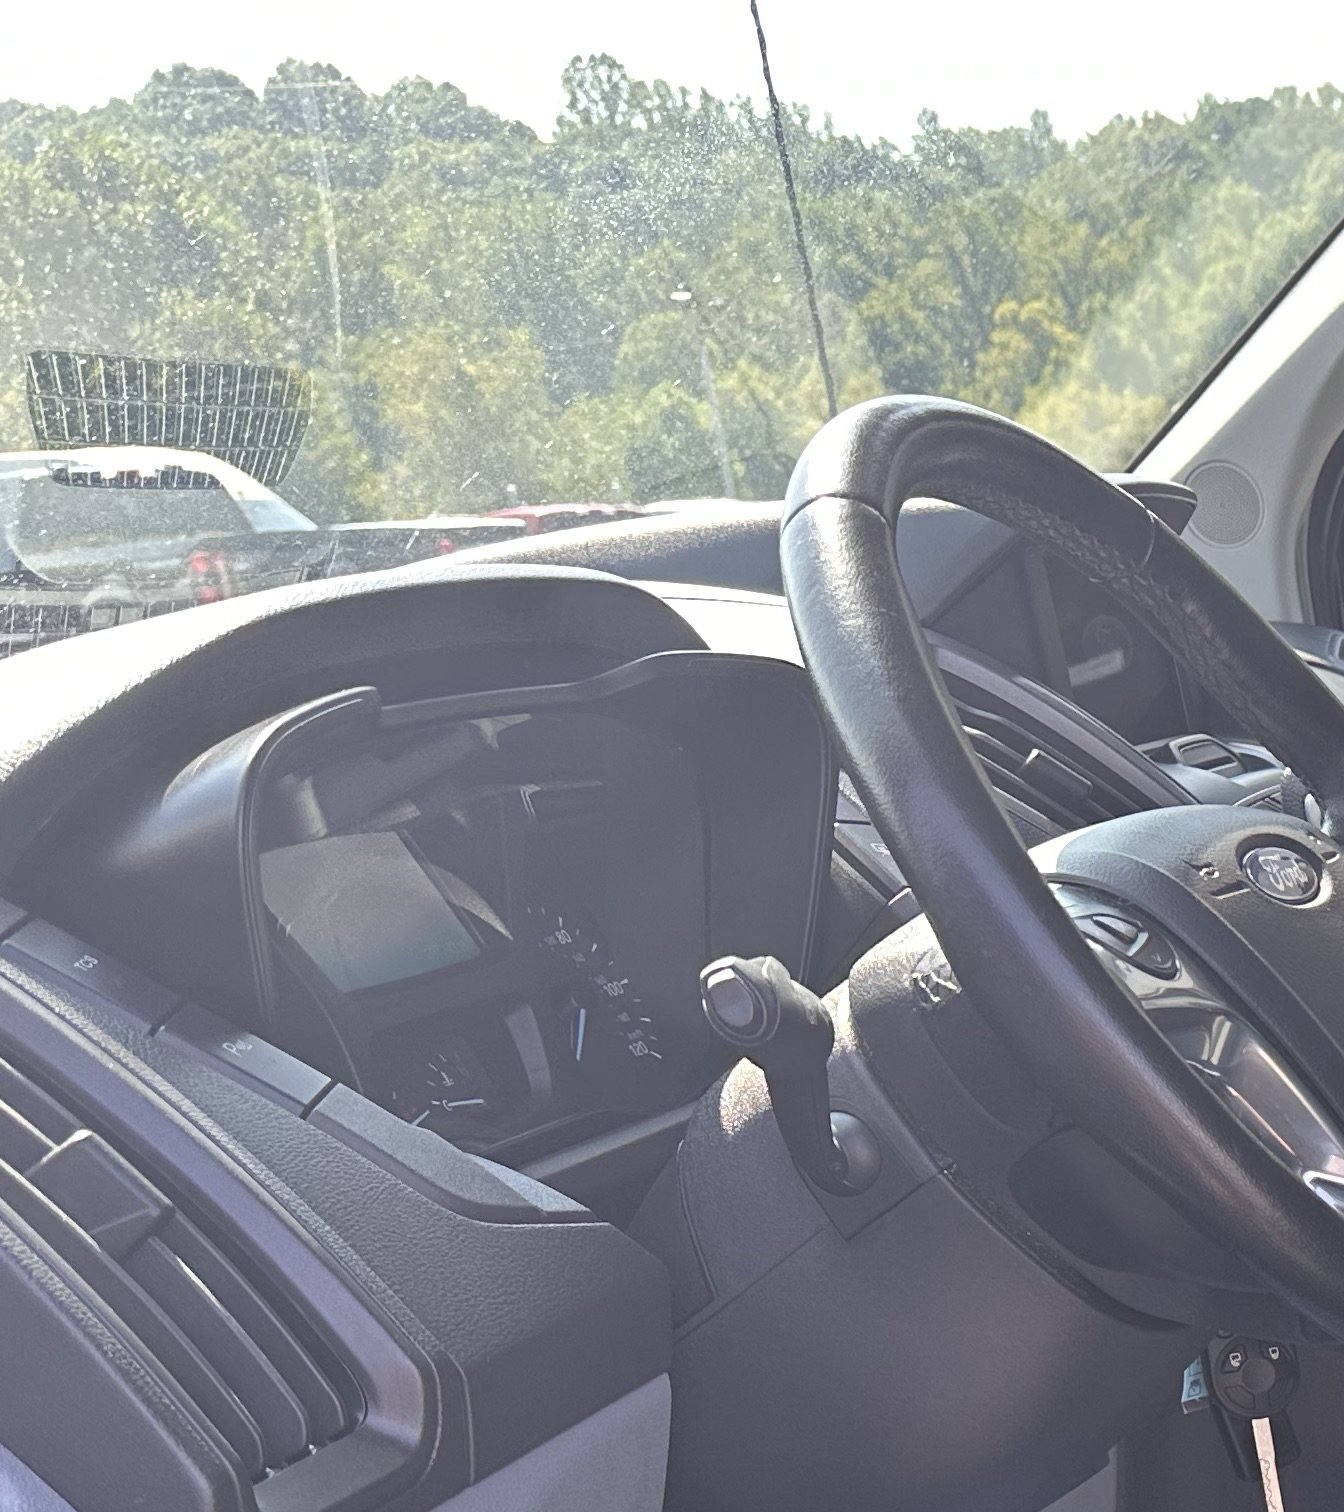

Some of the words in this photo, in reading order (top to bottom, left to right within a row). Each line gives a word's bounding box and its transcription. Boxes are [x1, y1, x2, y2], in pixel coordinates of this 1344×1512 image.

[1258, 853, 1309, 891] Ford
[555, 929, 572, 945] 80
[602, 980, 624, 997] 100
[628, 1040, 649, 1057] 120
